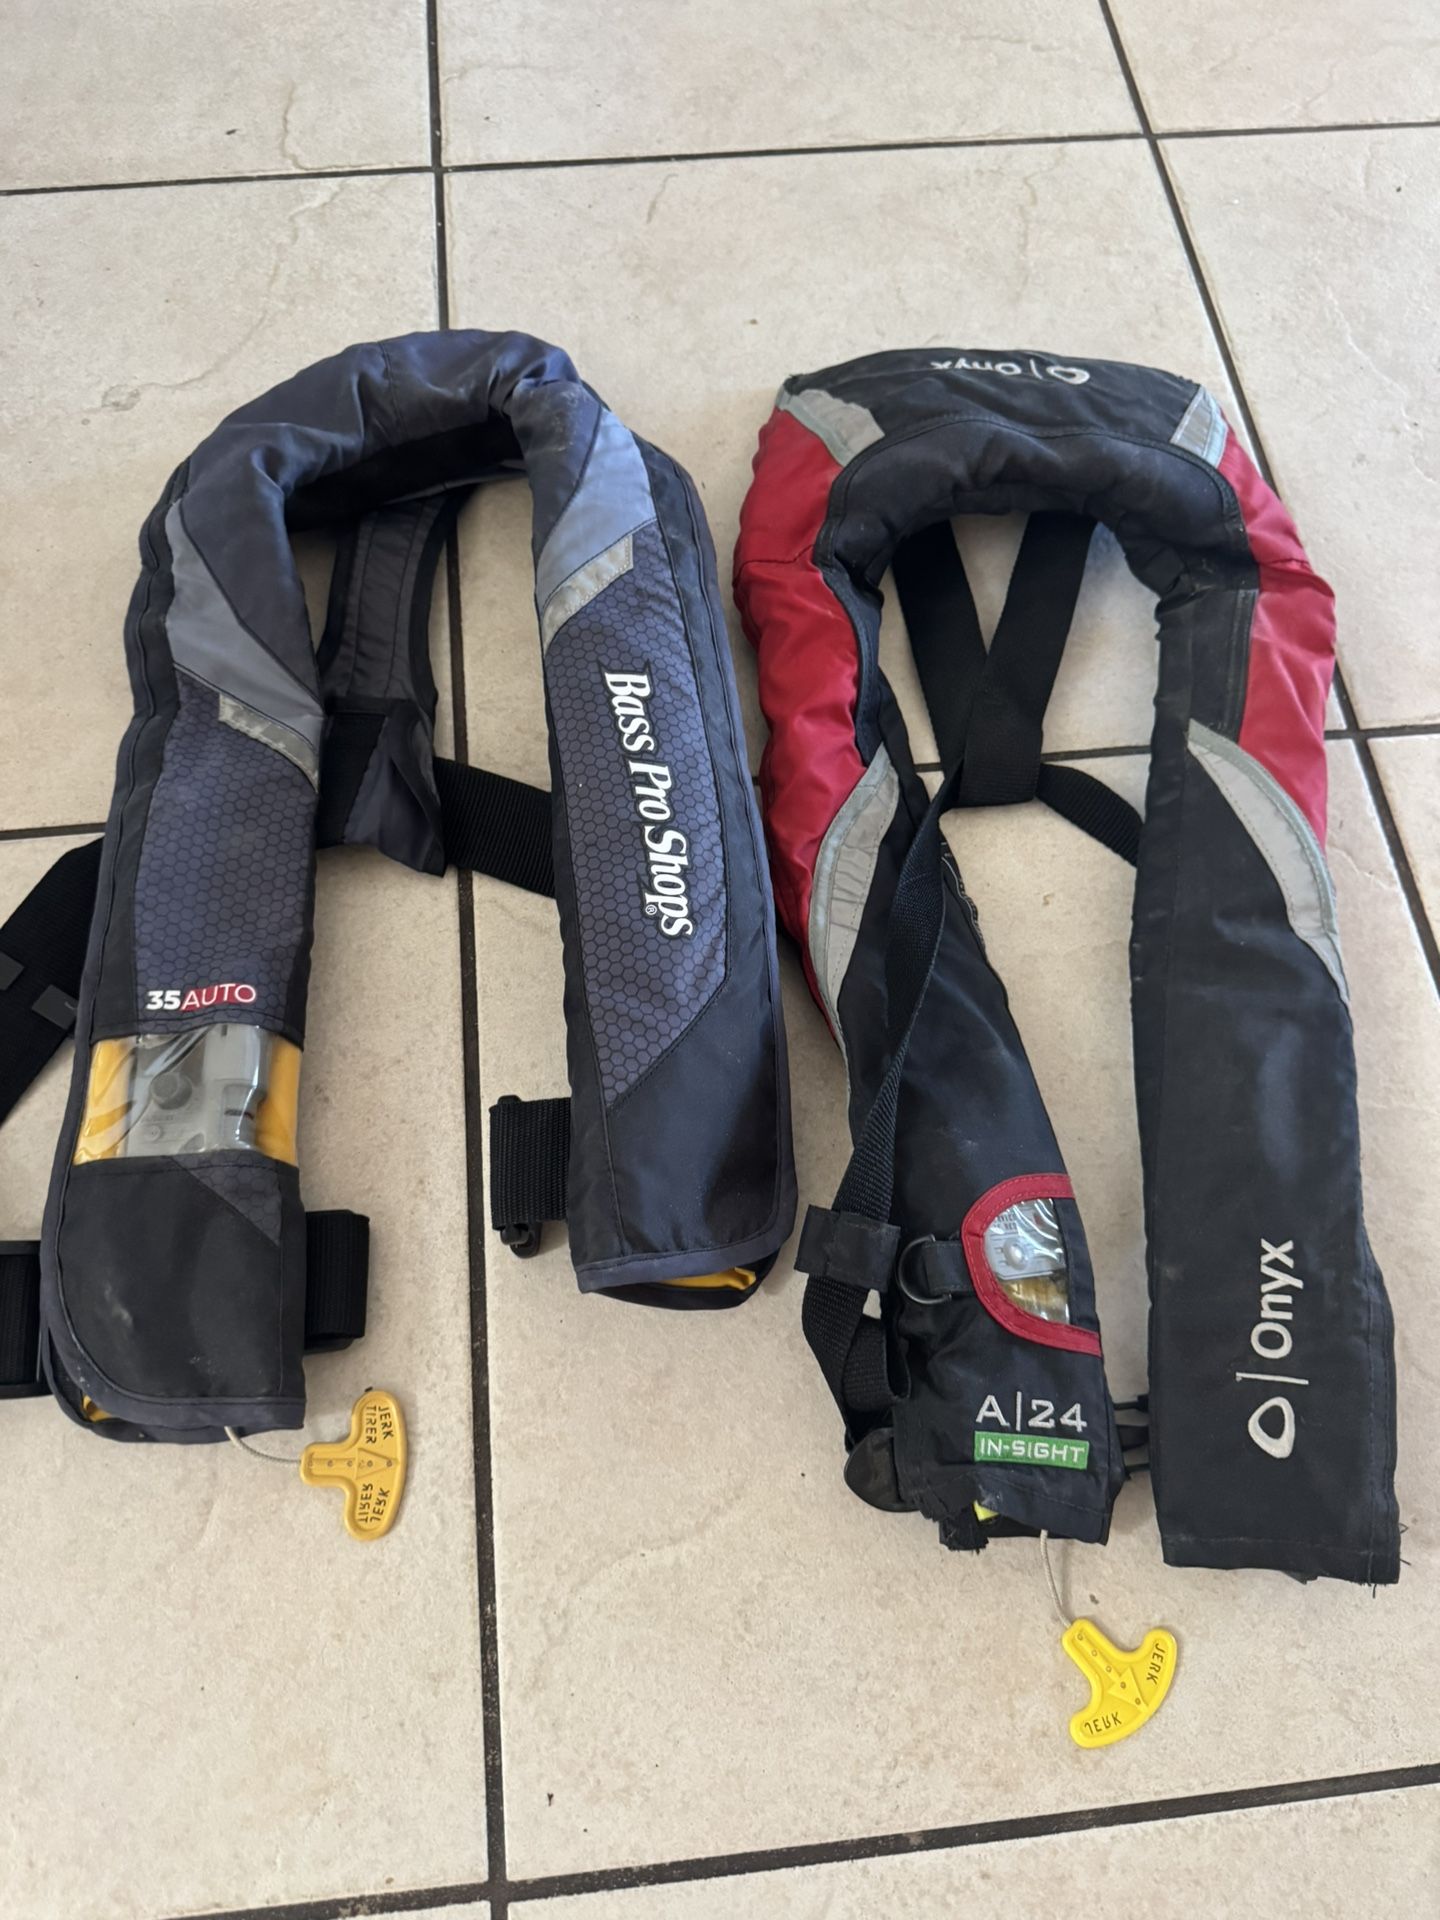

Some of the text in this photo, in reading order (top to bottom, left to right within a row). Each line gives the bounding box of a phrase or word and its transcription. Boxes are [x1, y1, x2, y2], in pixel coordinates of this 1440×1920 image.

[604, 672, 655, 752] Bass
[628, 760, 673, 821] Pro
[1250, 1238, 1304, 1359] Onyx
[366, 1405, 377, 1444] TIRER
[378, 1406, 394, 1440] JERK
[979, 1438, 1085, 1463] IN-SIGHT
[1146, 1643, 1166, 1685] JERK
